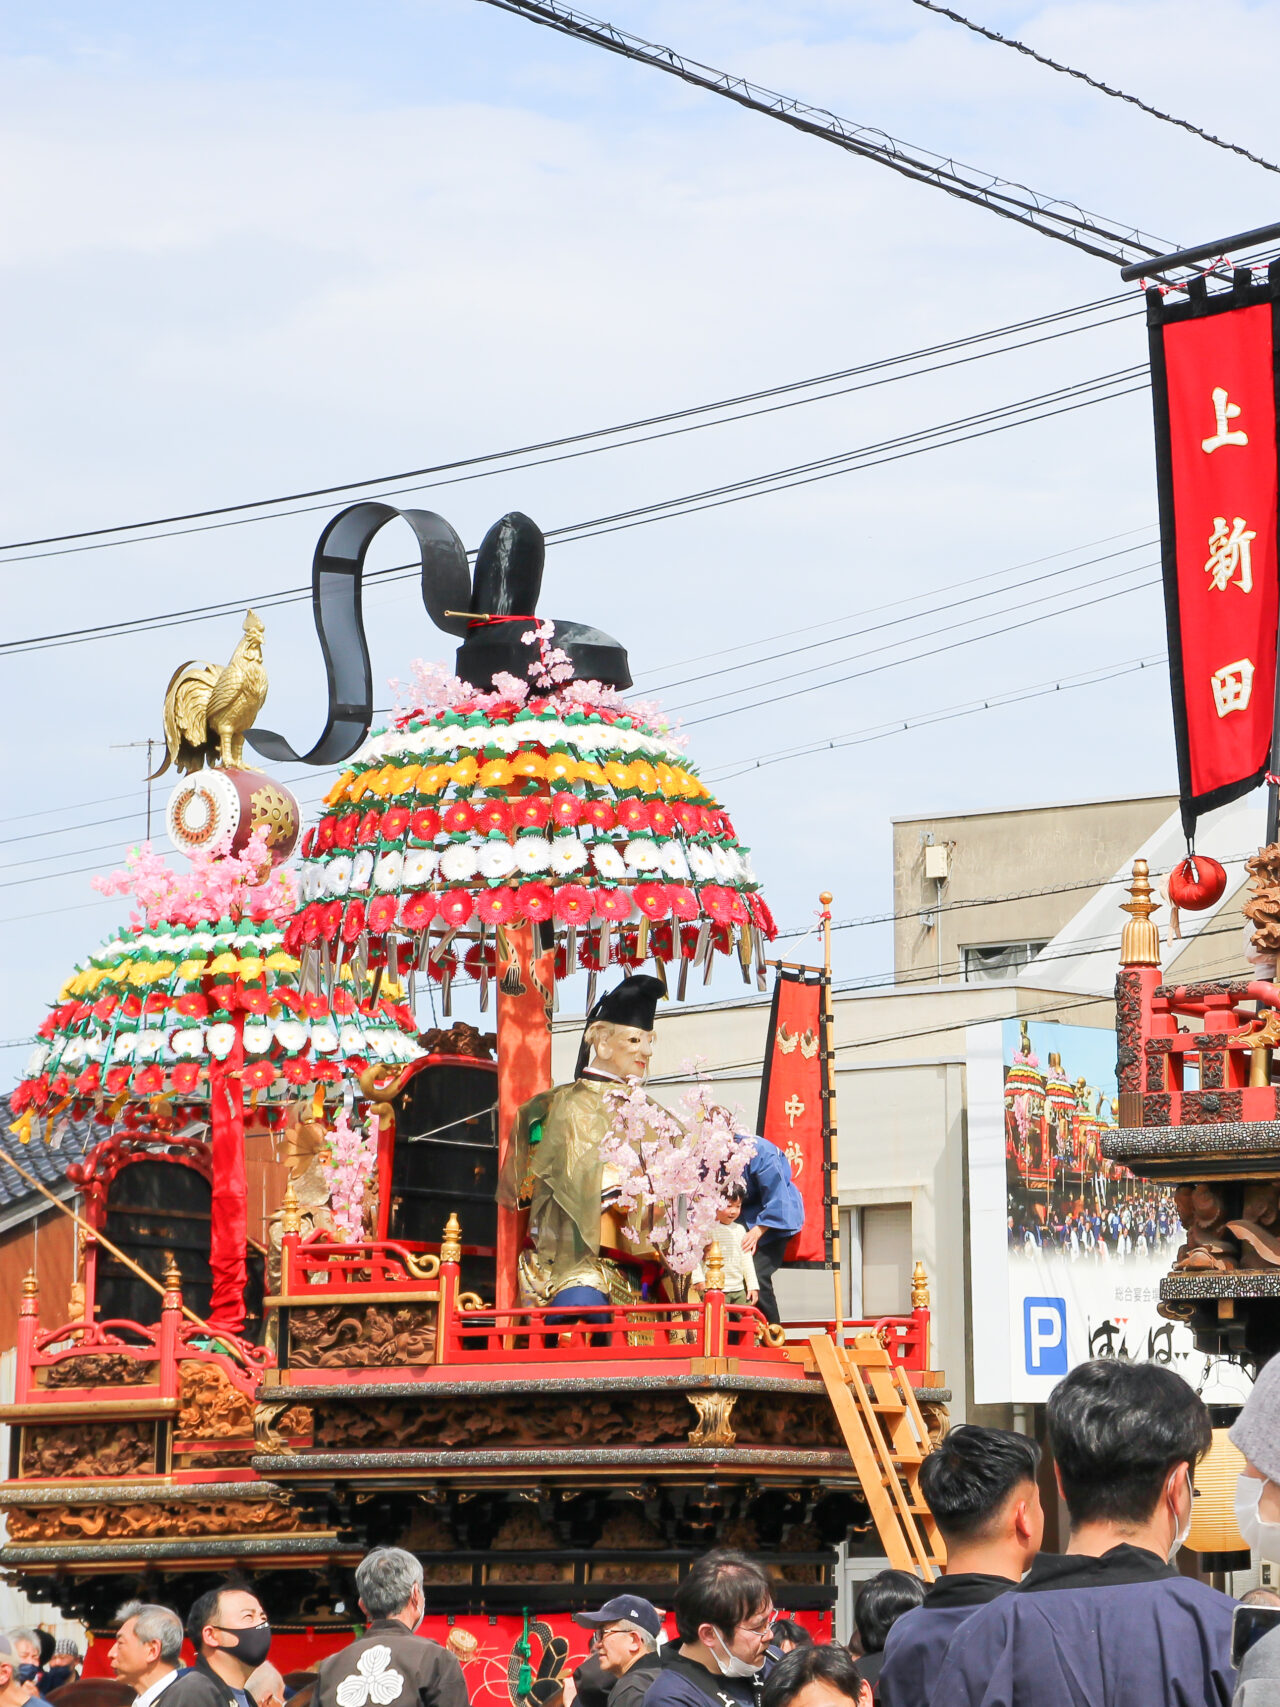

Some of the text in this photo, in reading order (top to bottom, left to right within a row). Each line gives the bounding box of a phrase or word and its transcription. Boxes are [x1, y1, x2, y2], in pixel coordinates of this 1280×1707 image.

[1201, 387, 1257, 719] 上新田
[784, 1094, 805, 1200] 中新
[1030, 1305, 1062, 1368] P
